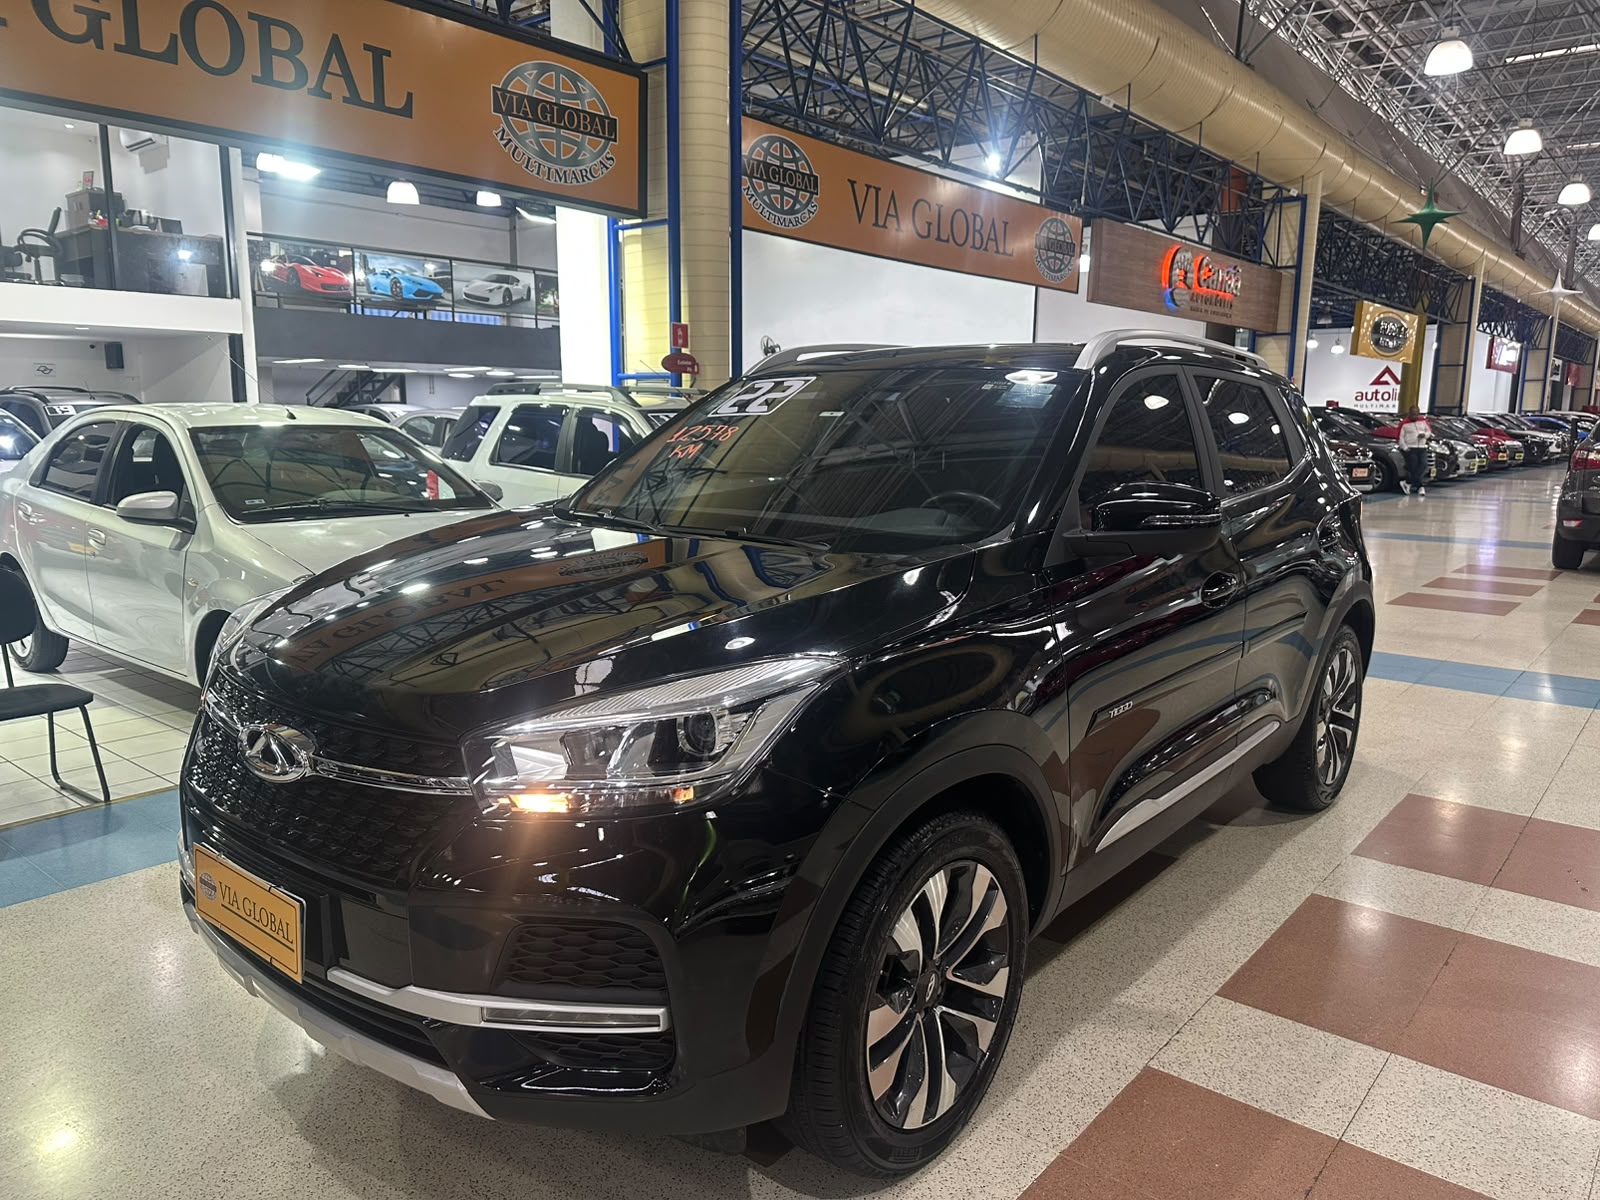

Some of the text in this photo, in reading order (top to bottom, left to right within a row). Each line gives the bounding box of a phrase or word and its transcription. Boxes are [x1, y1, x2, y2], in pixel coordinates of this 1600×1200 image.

[30, 0, 413, 119] GLOBAL
[495, 89, 616, 139] VIA GLOBAL
[494, 126, 616, 184] MULTIMARCAS
[744, 158, 817, 193] VIA GLOBAL
[743, 185, 818, 228] MULTIMARCAS
[847, 178, 1014, 257] VIA GLOBAL
[717, 380, 806, 414] 22
[666, 424, 739, 443] 12578
[668, 443, 704, 459] KM
[218, 880, 240, 911] VIA
[242, 896, 294, 945] GLOBAL
